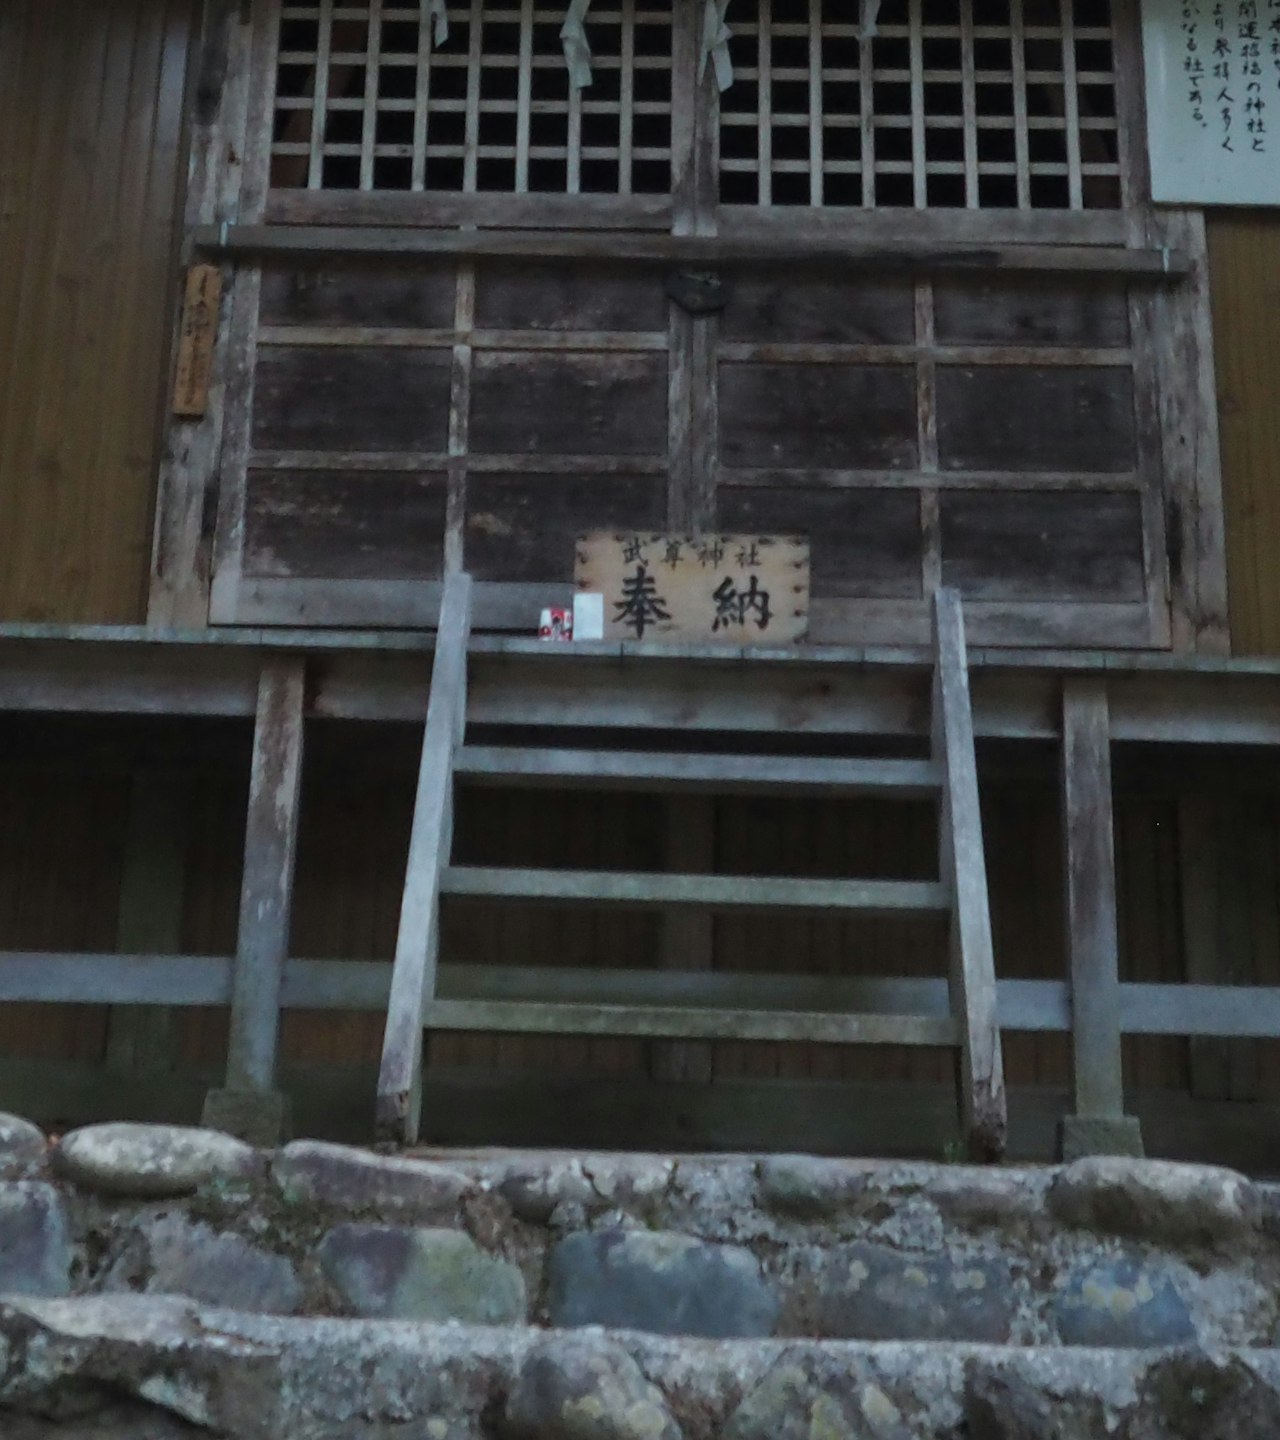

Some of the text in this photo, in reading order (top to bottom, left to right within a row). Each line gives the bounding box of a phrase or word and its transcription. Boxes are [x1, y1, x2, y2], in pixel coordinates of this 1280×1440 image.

[621, 536, 763, 570] 武尊神社
[611, 565, 774, 639] 奉納
